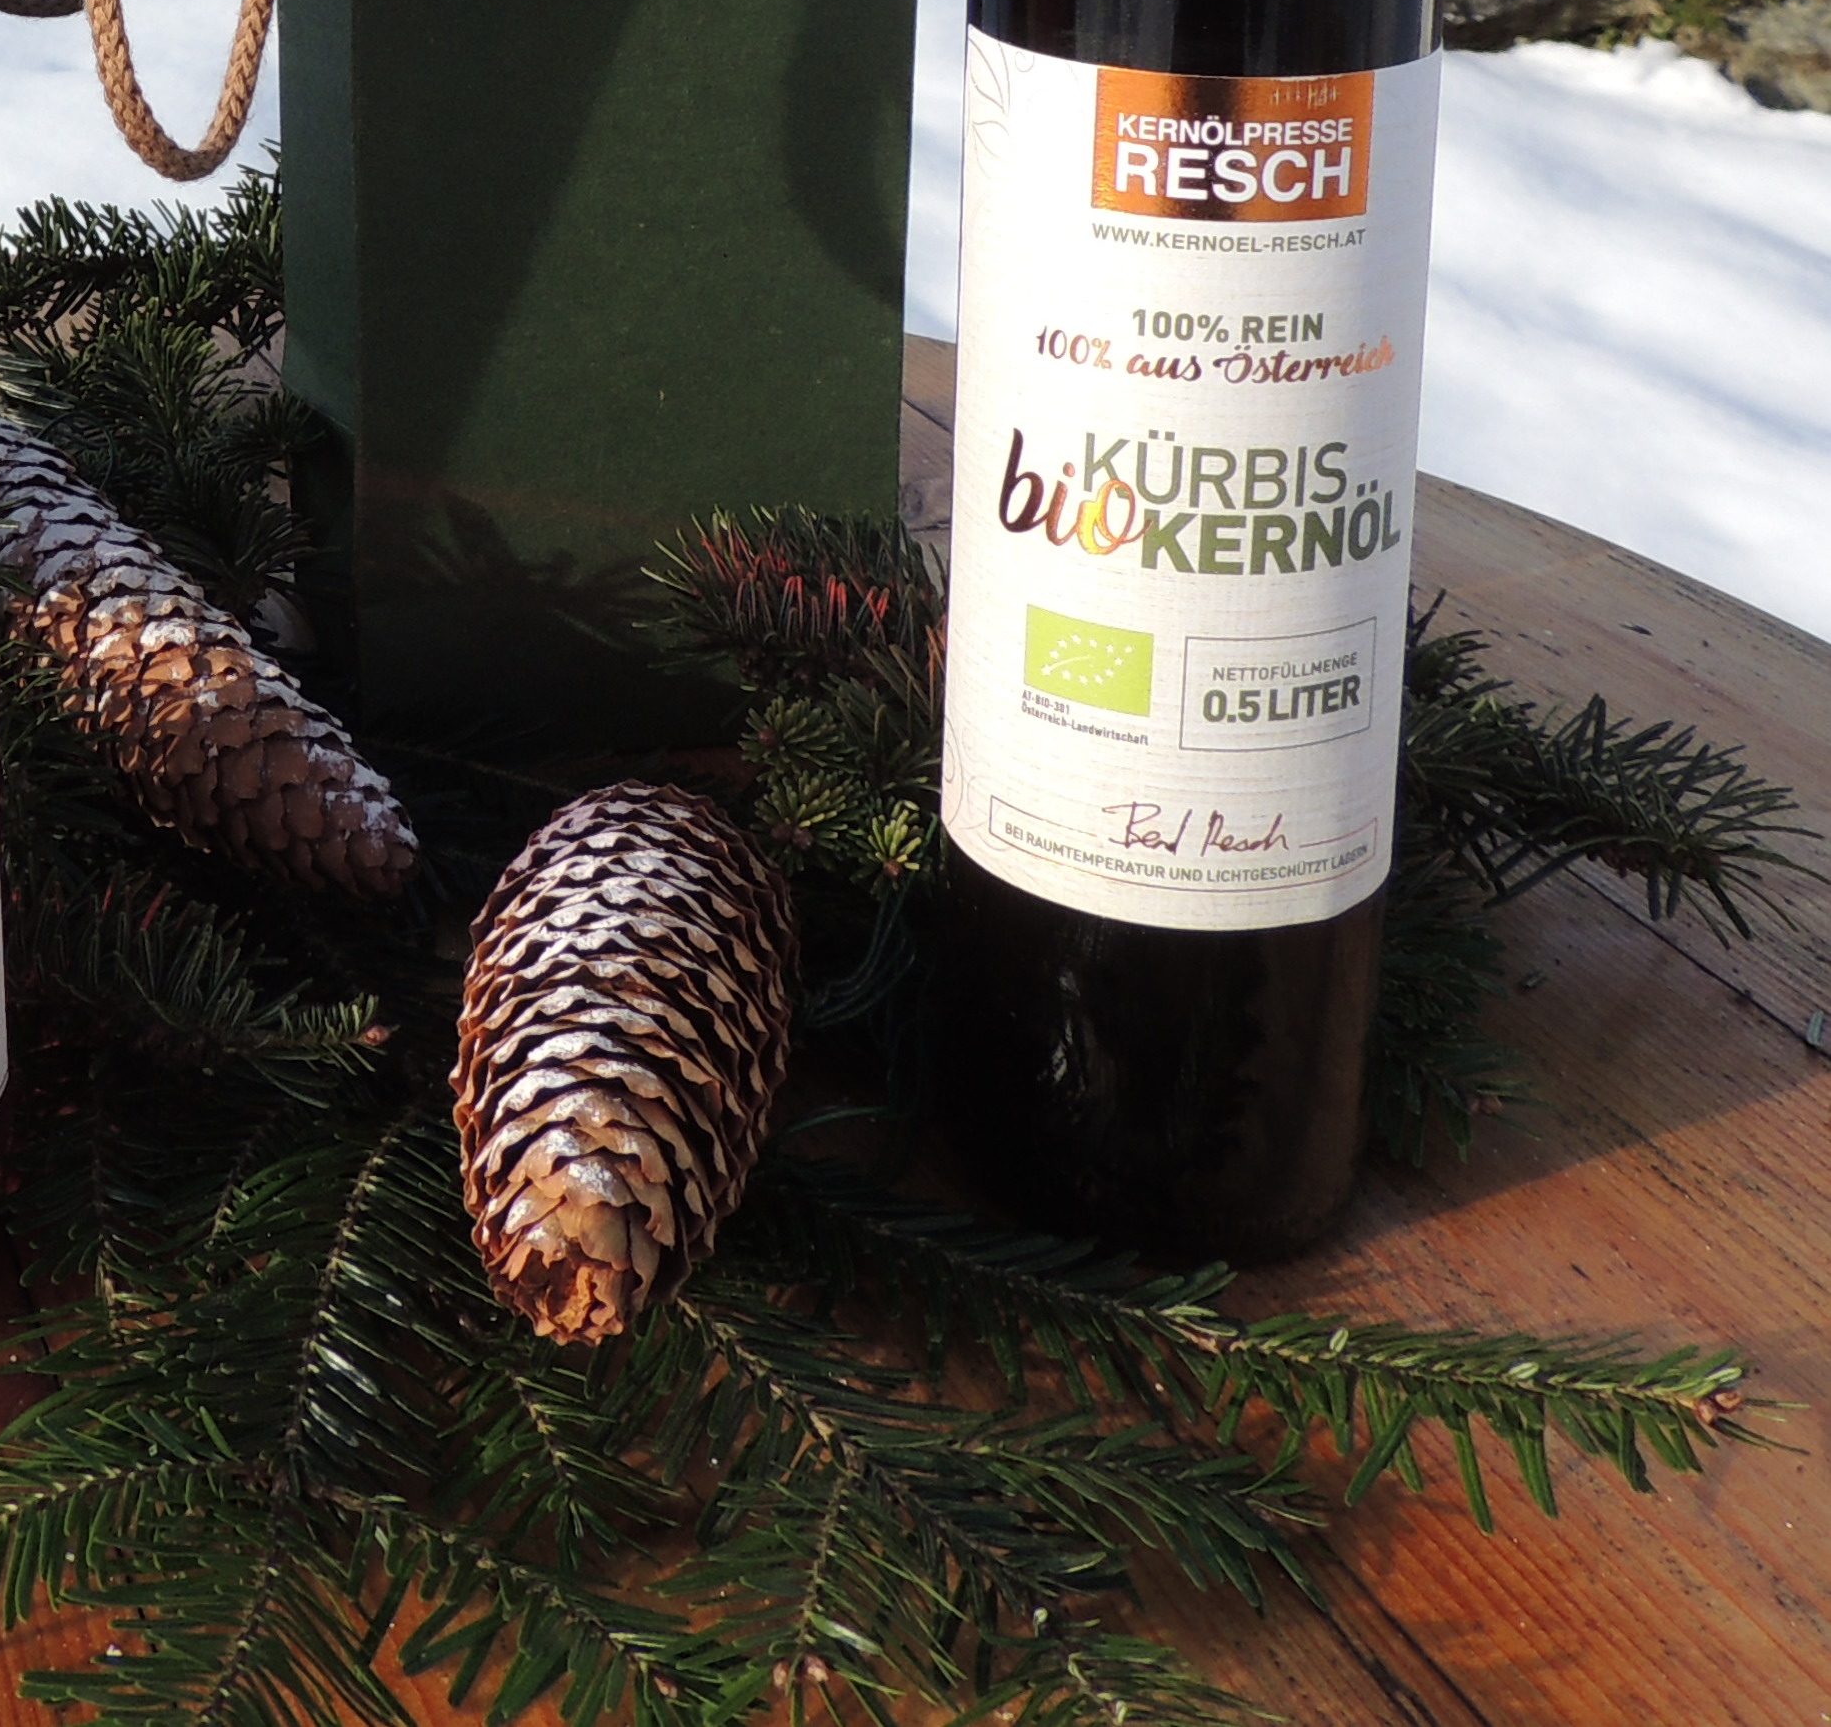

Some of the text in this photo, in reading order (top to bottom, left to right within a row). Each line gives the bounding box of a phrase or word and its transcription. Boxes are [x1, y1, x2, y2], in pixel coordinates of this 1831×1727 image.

[1117, 112, 1354, 146] KERNÖLPRESSE
[1114, 141, 1353, 204] RESCH
[1091, 222, 1367, 253] WWW.KERNOEL-RESCH.AT
[1036, 325, 1396, 385] 100% aus Österreich
[1132, 309, 1324, 344] 100% REIN
[999, 428, 1154, 556] bio
[1083, 429, 1349, 510] KÜRBIS
[1140, 479, 1402, 576] KERNÖL
[1212, 652, 1358, 683] NETTOFÜLLMENGE
[1202, 675, 1361, 723] 0.5 LITER
[1005, 822, 1024, 841] BEI
[1026, 831, 1165, 879] RAUMTEMPERATUR
[1169, 865, 1203, 882] UND
[1206, 859, 1329, 883] LICHTGESCHÜTZT
